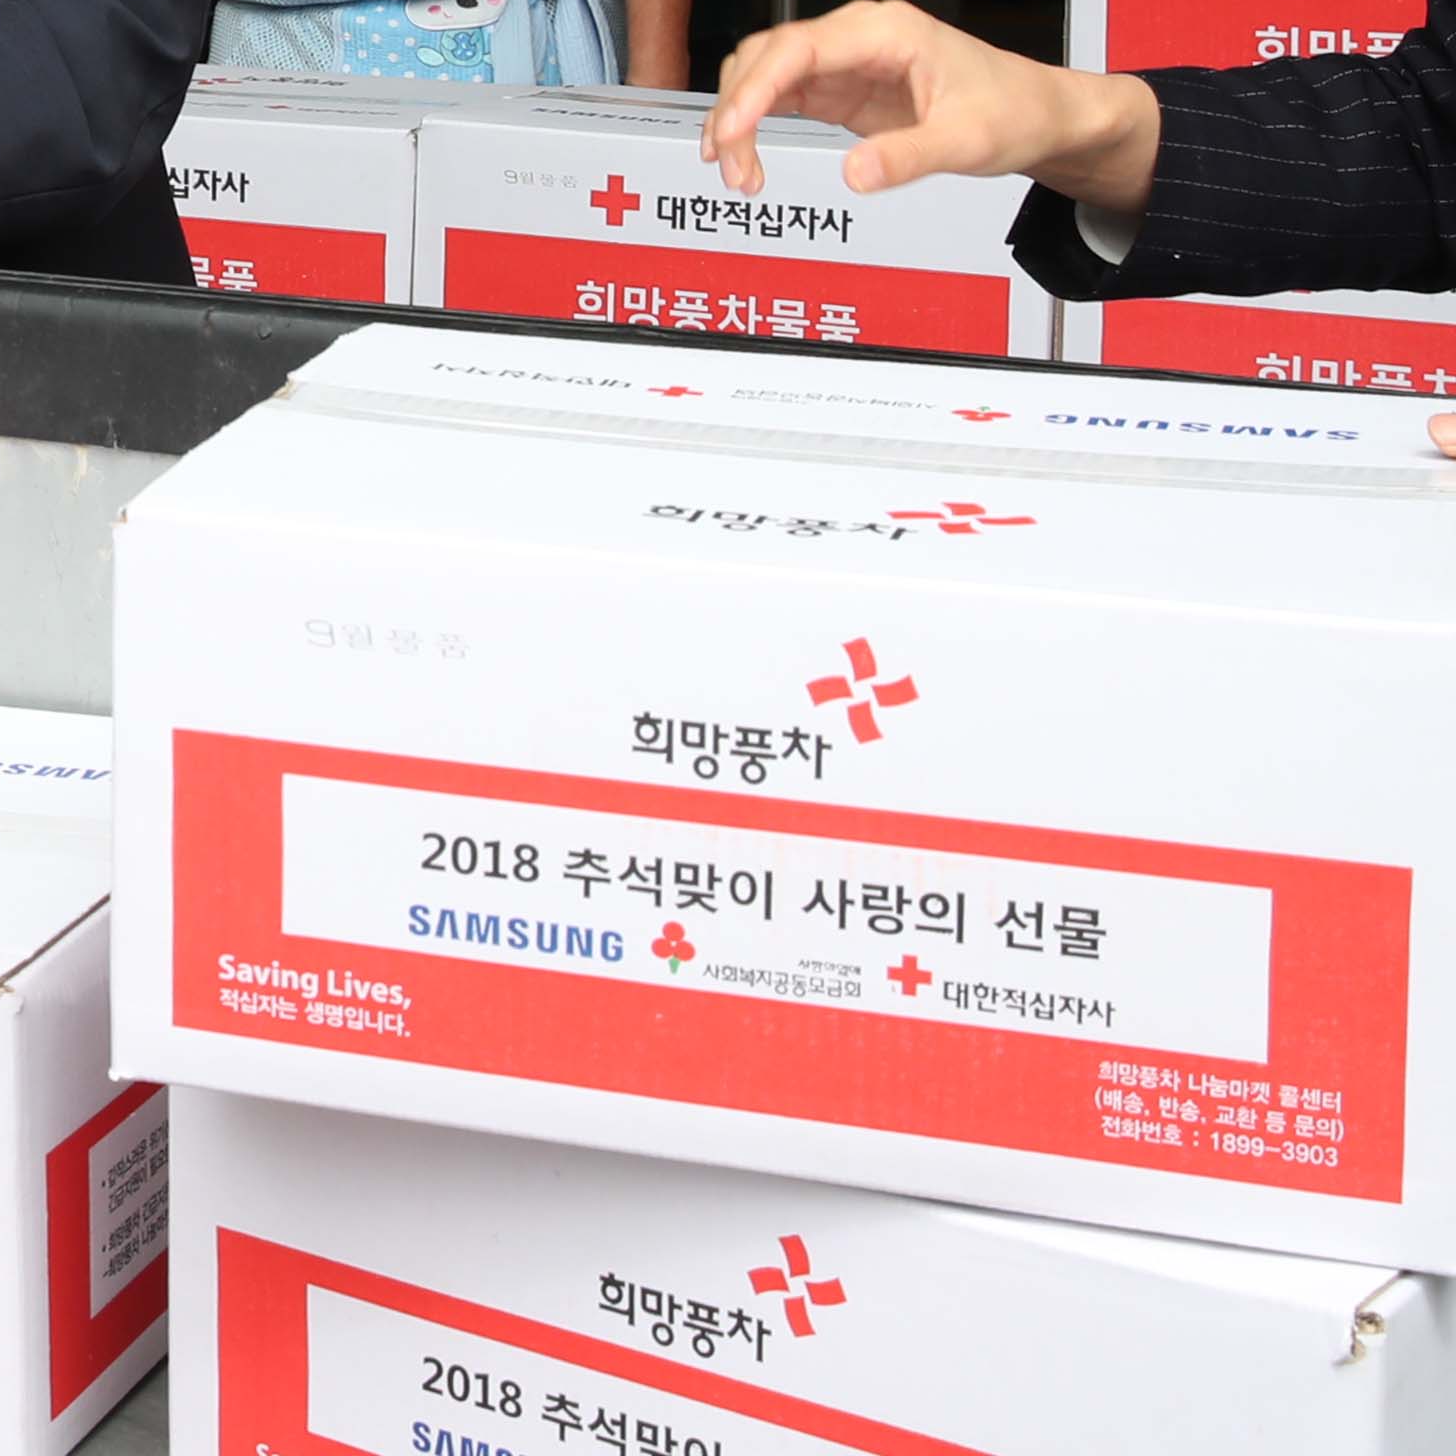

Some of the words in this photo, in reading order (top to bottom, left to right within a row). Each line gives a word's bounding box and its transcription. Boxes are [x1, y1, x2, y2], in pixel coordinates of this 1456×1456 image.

[657, 194, 854, 243] 대한적십자사
[1045, 413, 1360, 441] SAMSUNG
[643, 503, 920, 541] 희망풍차
[631, 710, 833, 785] 희망풍차
[420, 832, 541, 884] 2018
[563, 847, 776, 921] 추석맞이
[802, 875, 968, 943] 사랑의
[994, 898, 1108, 962] 선물
[408, 904, 624, 963] SAMSUNG
[218, 953, 319, 999] Saving
[327, 969, 412, 1010] Lives,
[702, 962, 862, 999] 사회복지공동모금회
[942, 979, 1117, 1028] 대한적십자사
[220, 987, 298, 1021] 적십자는
[305, 1000, 412, 1038] 생명입니다.
[1094, 1086, 1150, 1117] (배송,
[1159, 1097, 1207, 1124] 반송,
[1216, 1105, 1258, 1131] 교환
[1265, 1111, 1287, 1135] 등
[1294, 1114, 1345, 1142] 문의)
[1098, 1060, 1181, 1093] 희망풍차
[1189, 1072, 1271, 1105] 나눔마켓
[1279, 1084, 1343, 1114] 콜센터
[1101, 1115, 1184, 1147] 전화번호
[599, 1271, 772, 1362] 희망풍차
[421, 1356, 524, 1419] 2018
